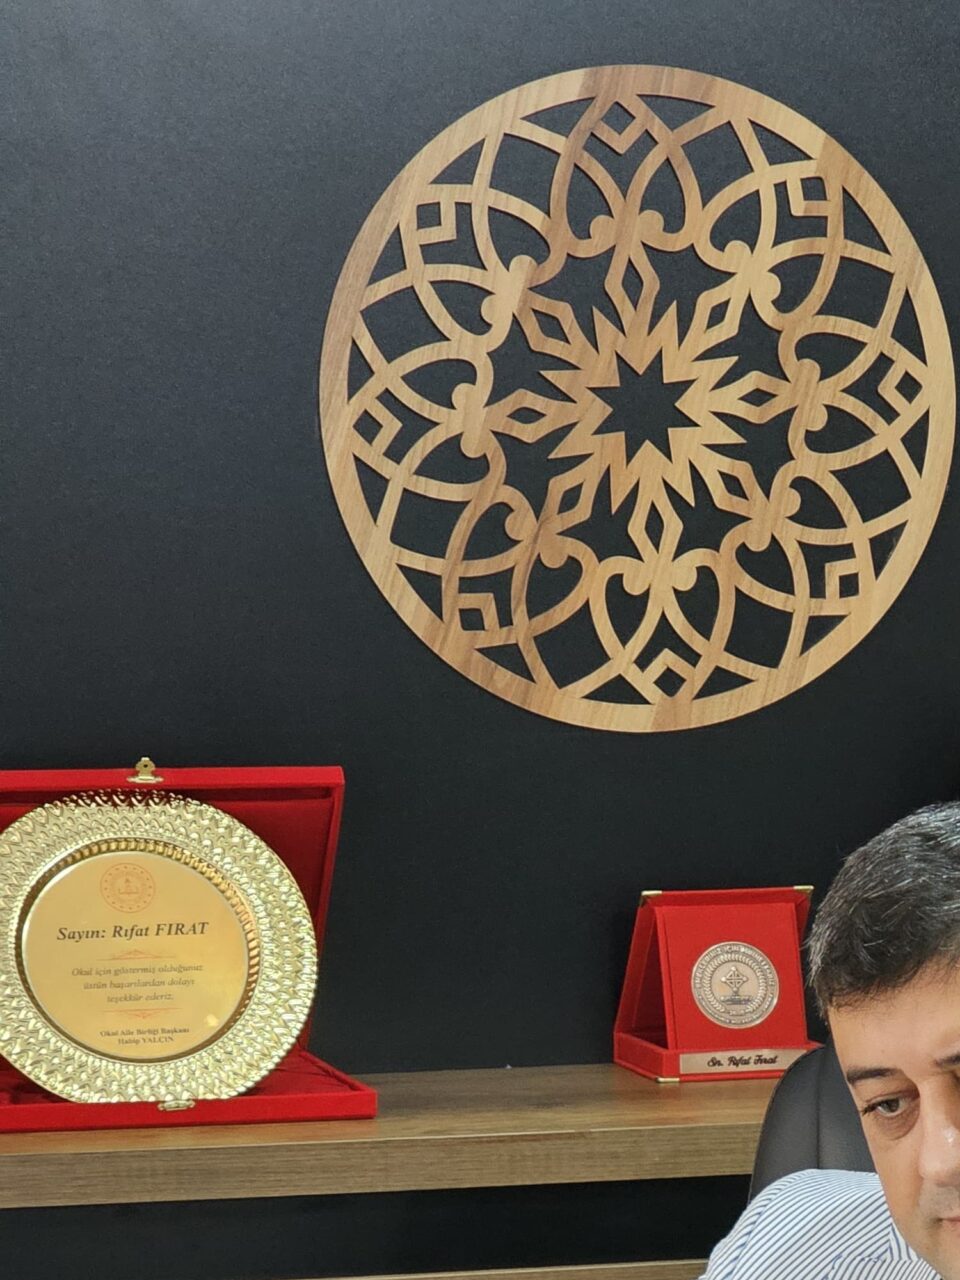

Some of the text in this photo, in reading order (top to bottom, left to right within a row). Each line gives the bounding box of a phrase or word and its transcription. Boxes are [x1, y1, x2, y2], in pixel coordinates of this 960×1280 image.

[56, 921, 210, 943] Sayın: Rıfat FIRAT
